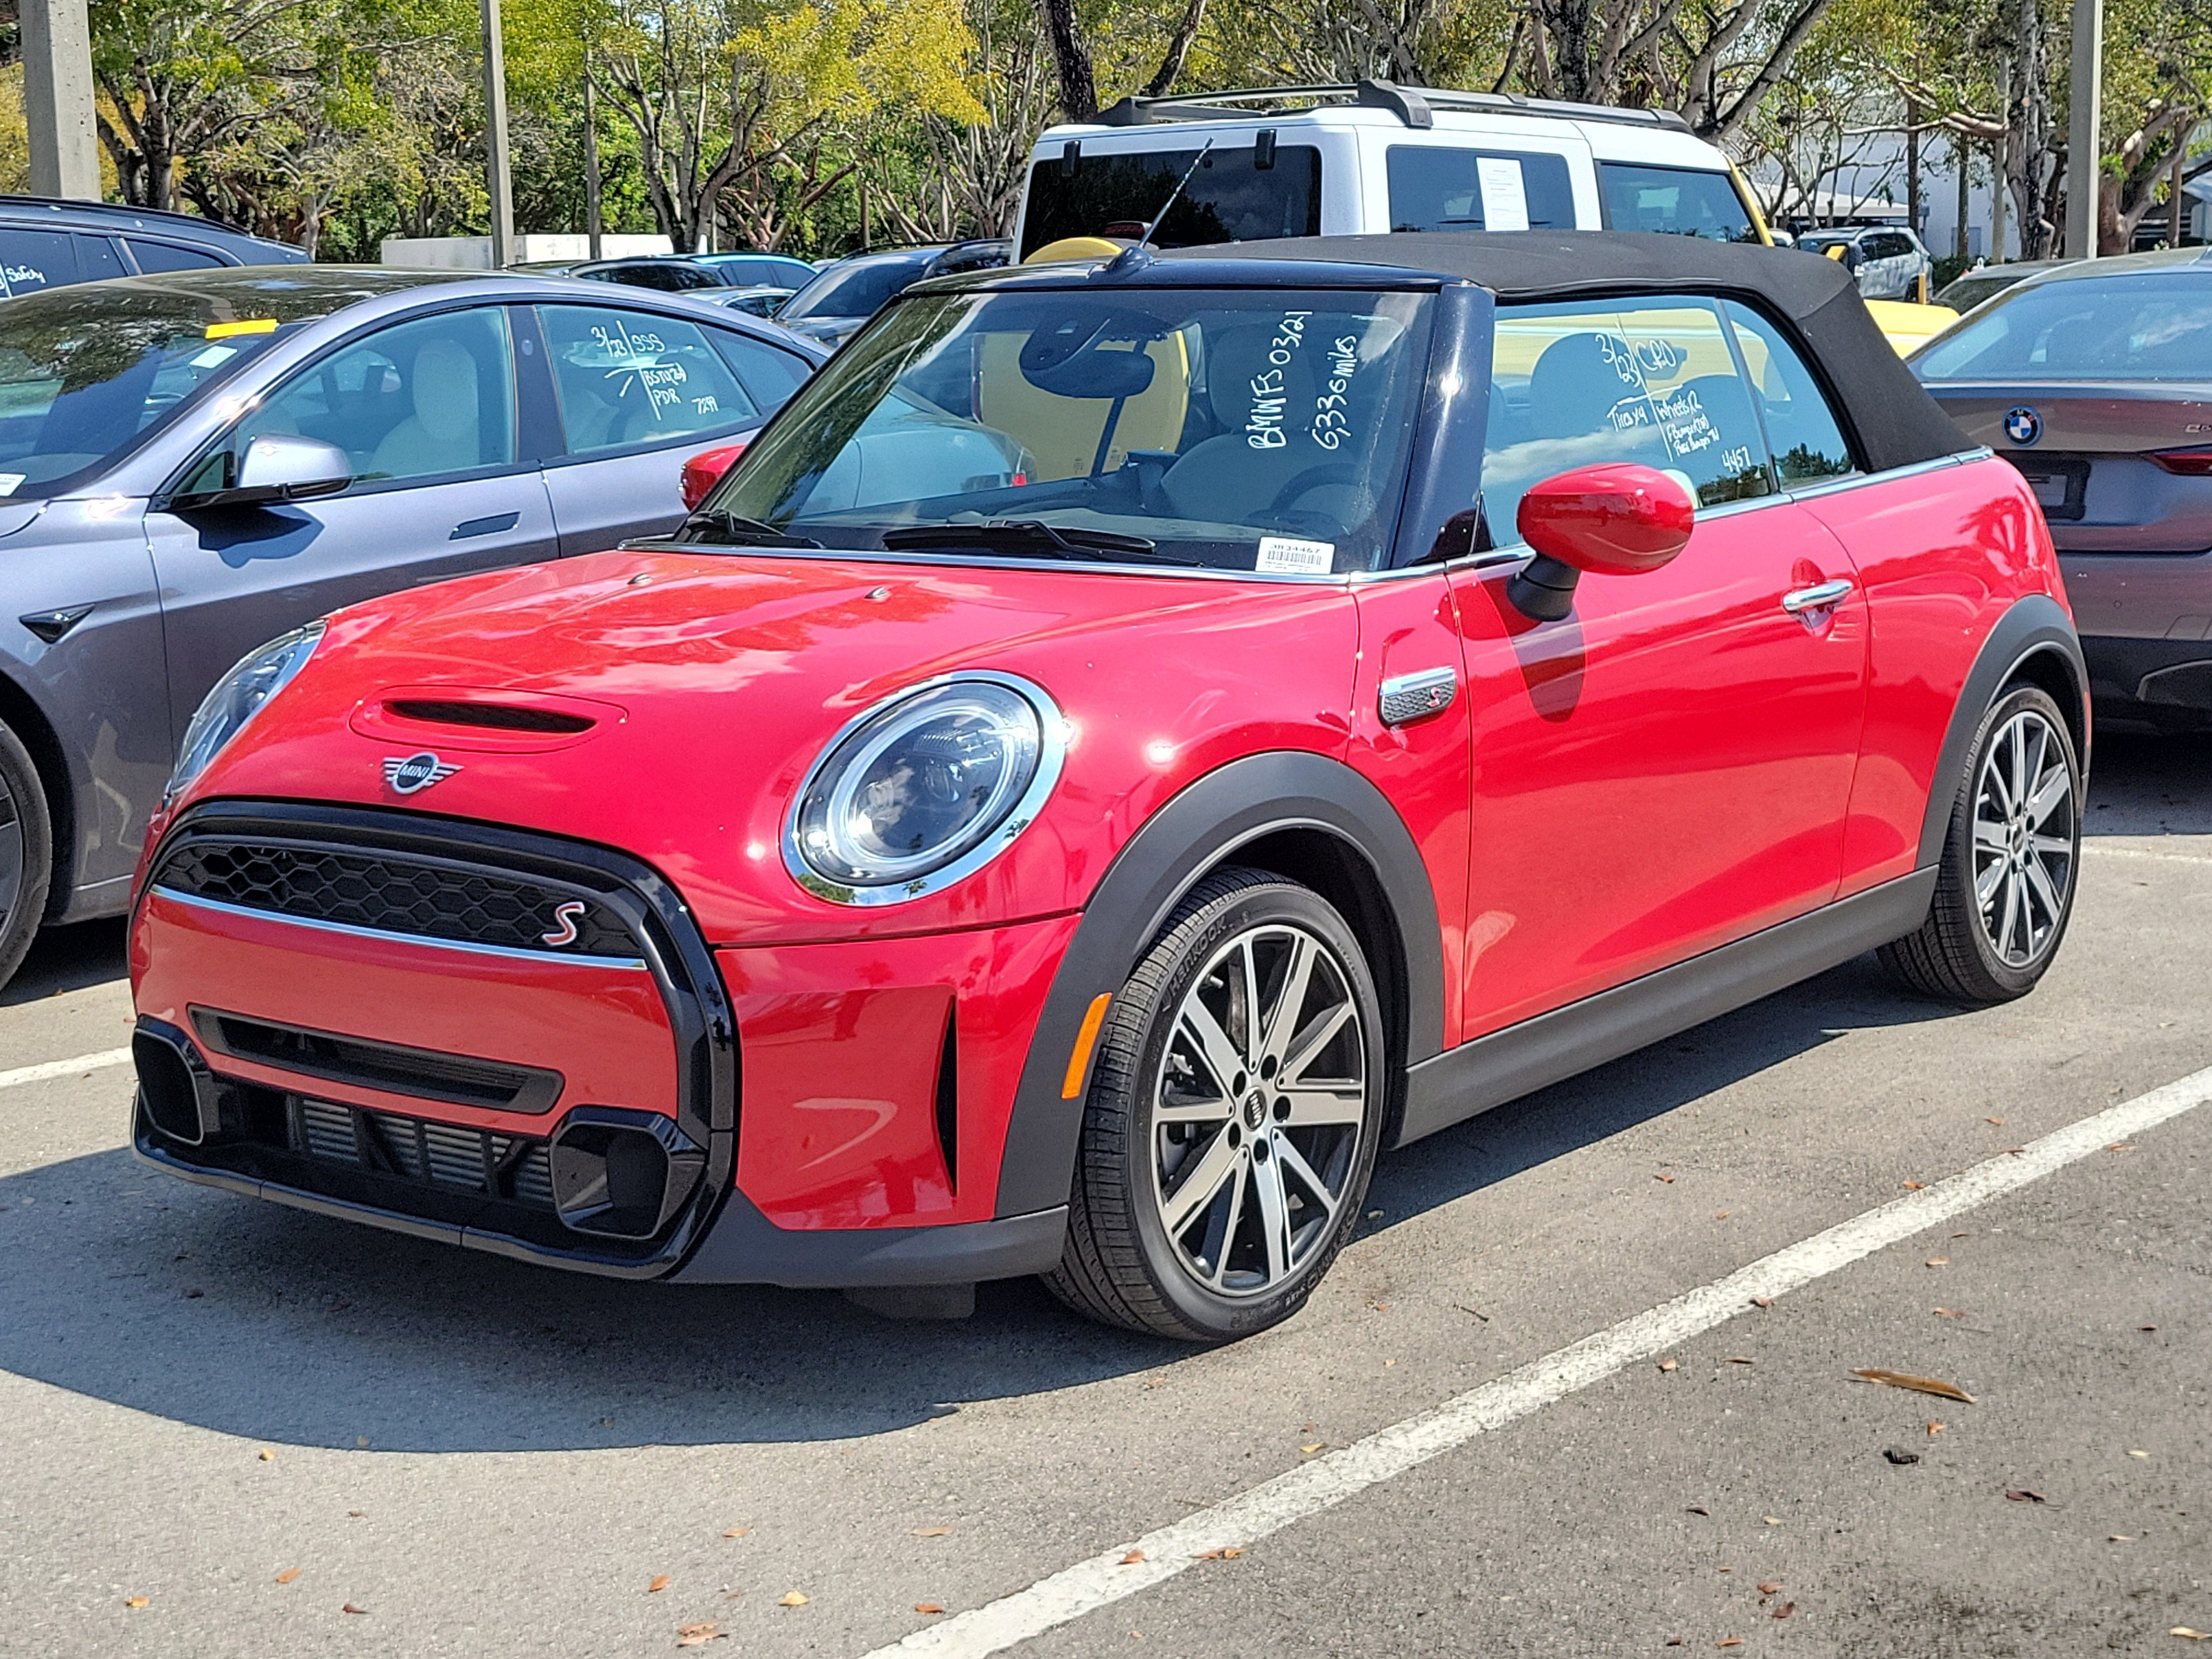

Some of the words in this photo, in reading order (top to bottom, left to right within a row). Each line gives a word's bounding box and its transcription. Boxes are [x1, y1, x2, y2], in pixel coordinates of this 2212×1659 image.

[652, 388, 681, 406] PDR
[400, 764, 430, 778] MINI
[541, 901, 585, 946] S
[1249, 1093, 1262, 1125] MINI
